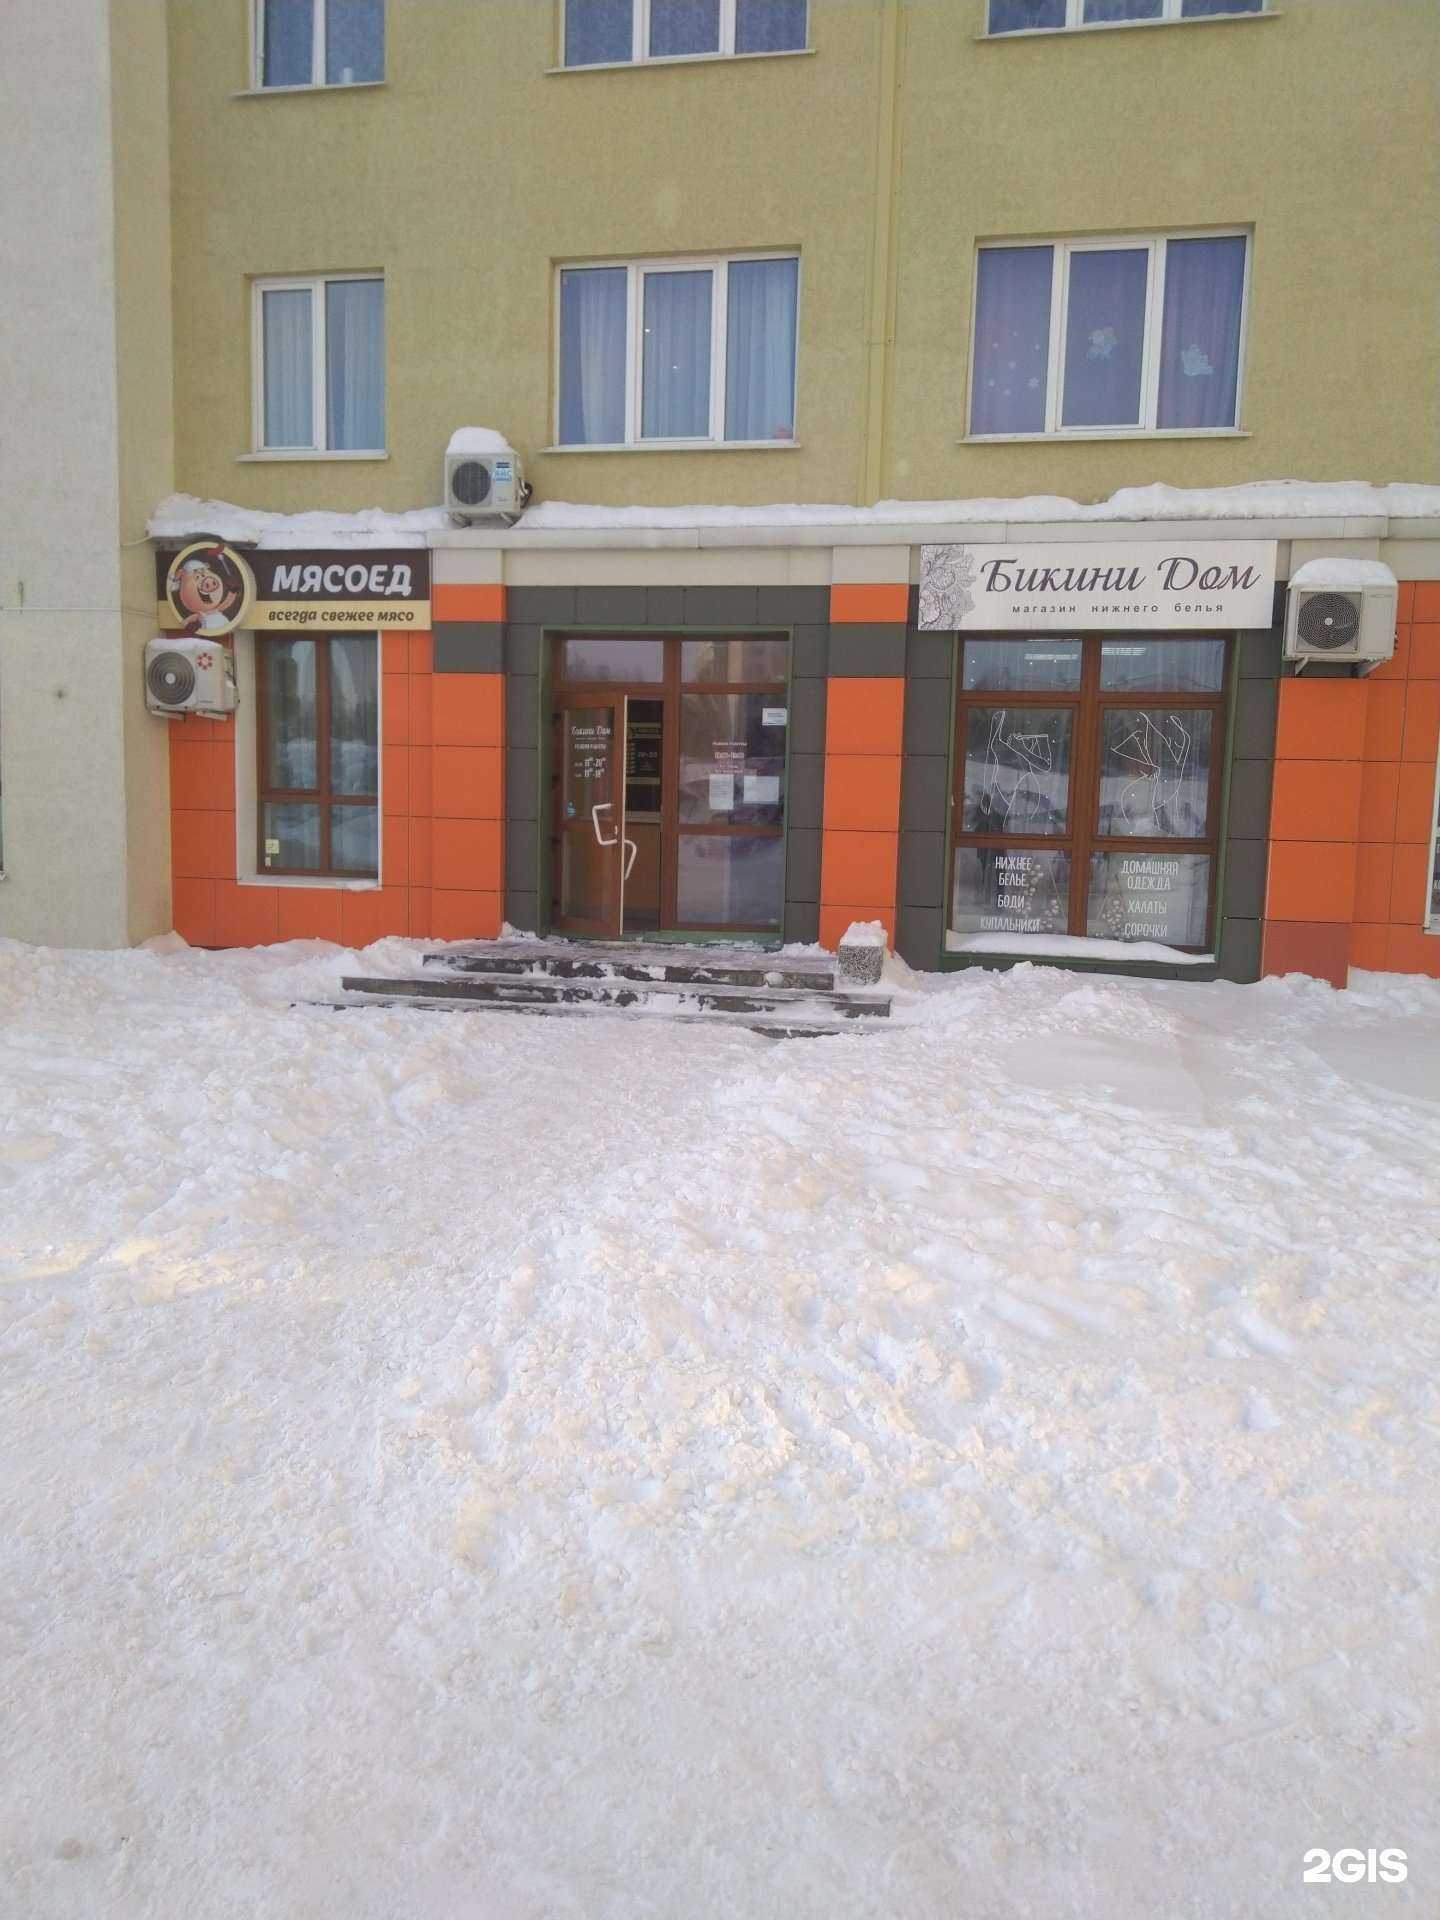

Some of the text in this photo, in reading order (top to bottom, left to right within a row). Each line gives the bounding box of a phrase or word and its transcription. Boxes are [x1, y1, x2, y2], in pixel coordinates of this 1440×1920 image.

[272, 564, 412, 597] МЯСОЕД
[980, 557, 1262, 592] Бикини Дом
[1012, 602, 1224, 614] магазин нижнего белья
[268, 610, 414, 624] всегда свежее мясо
[995, 856, 1032, 870] НИЖНЕЕ
[1121, 860, 1179, 875] ДОМАШНЯЯ
[998, 872, 1026, 887] БЕЛЬЕ
[1127, 876, 1171, 890] ОДЕЖДА
[997, 894, 1025, 909] БОДИ
[1128, 900, 1167, 914] ХАЛАТЫ
[980, 916, 1041, 932] КУПАЛЬНИКИ
[1124, 922, 1167, 937] СОРОЧКИ
